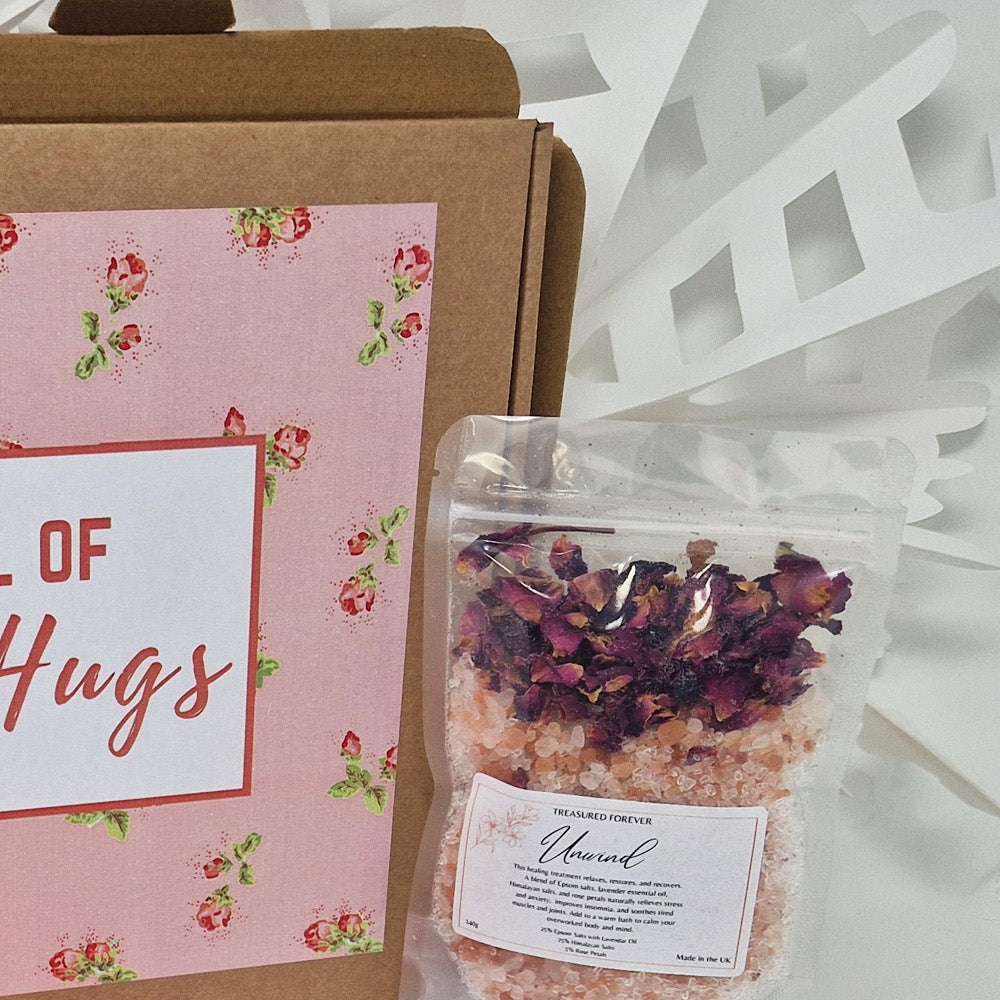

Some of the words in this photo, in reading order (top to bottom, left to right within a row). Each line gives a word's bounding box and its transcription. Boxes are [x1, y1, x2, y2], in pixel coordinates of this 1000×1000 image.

[38, 516, 112, 583] OF
[553, 808, 607, 821] TREASURED
[609, 814, 652, 825] FOREVER
[538, 825, 659, 870] Unwind
[513, 863, 526, 871] This
[526, 866, 549, 877] healing
[550, 871, 581, 881] treatment
[609, 879, 637, 887] restores,
[509, 881, 540, 892] Himalayan
[587, 895, 606, 903] petals
[637, 899, 662, 907] relieves
[530, 876, 548, 884] blend
[557, 881, 579, 890] Epsom
[598, 886, 626, 895] lavender
[627, 889, 656, 897] essential
[512, 901, 535, 909] muscles
[555, 899, 583, 909] improves
[584, 904, 615, 912] insomnia,
[546, 917, 583, 927] overworked
[584, 922, 599, 930] body
[571, 940, 600, 949] Himalayan
